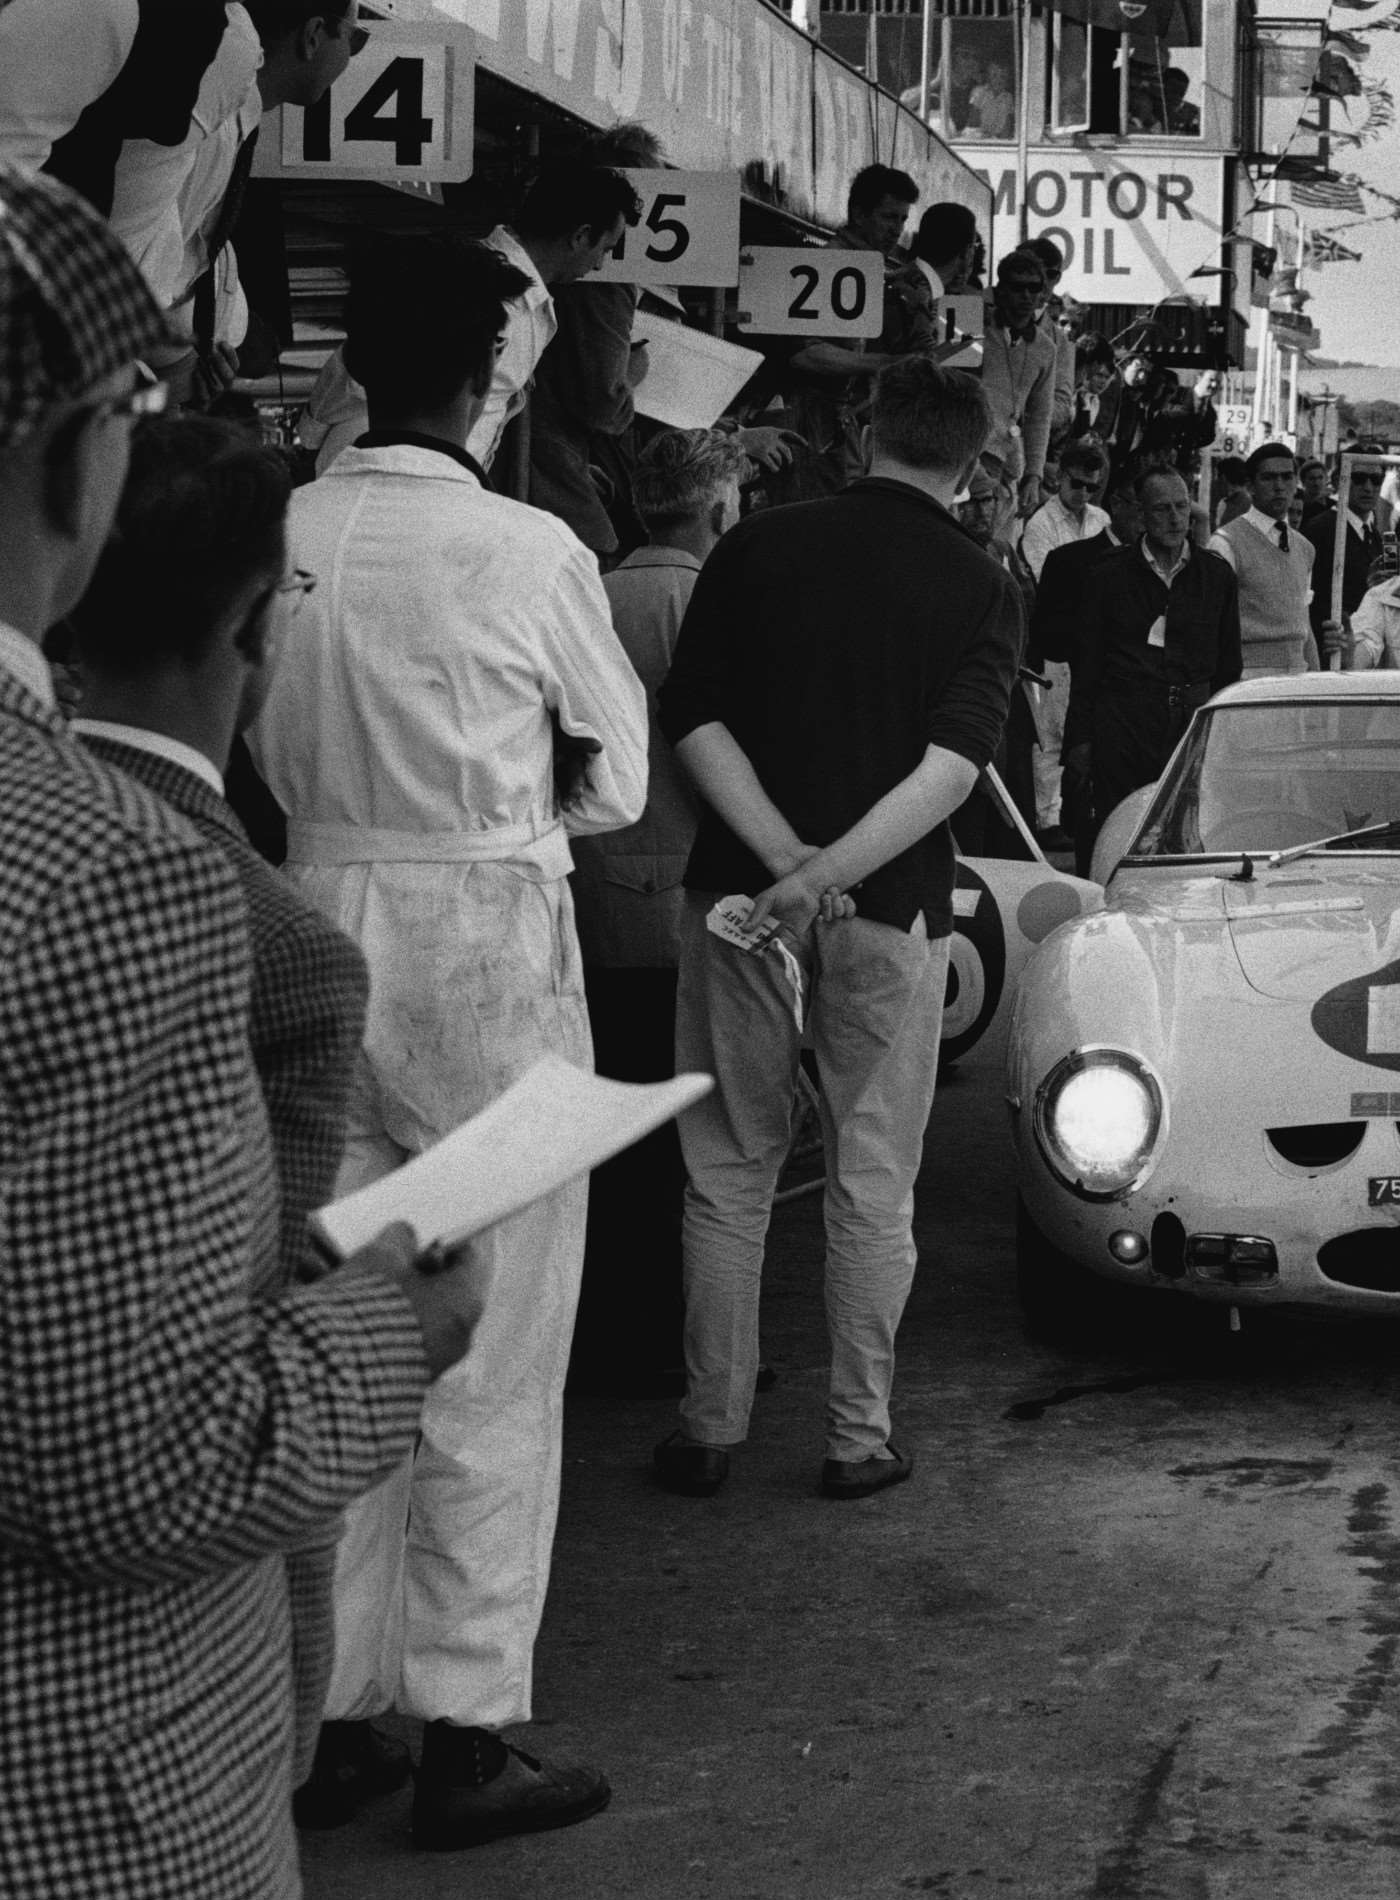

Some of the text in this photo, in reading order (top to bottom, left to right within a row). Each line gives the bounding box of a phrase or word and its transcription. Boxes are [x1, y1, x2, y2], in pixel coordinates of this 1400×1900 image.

[303, 56, 433, 166] 14
[974, 168, 1194, 221] MOTOR
[788, 265, 866, 320] 20
[1227, 410, 1246, 424] 29
